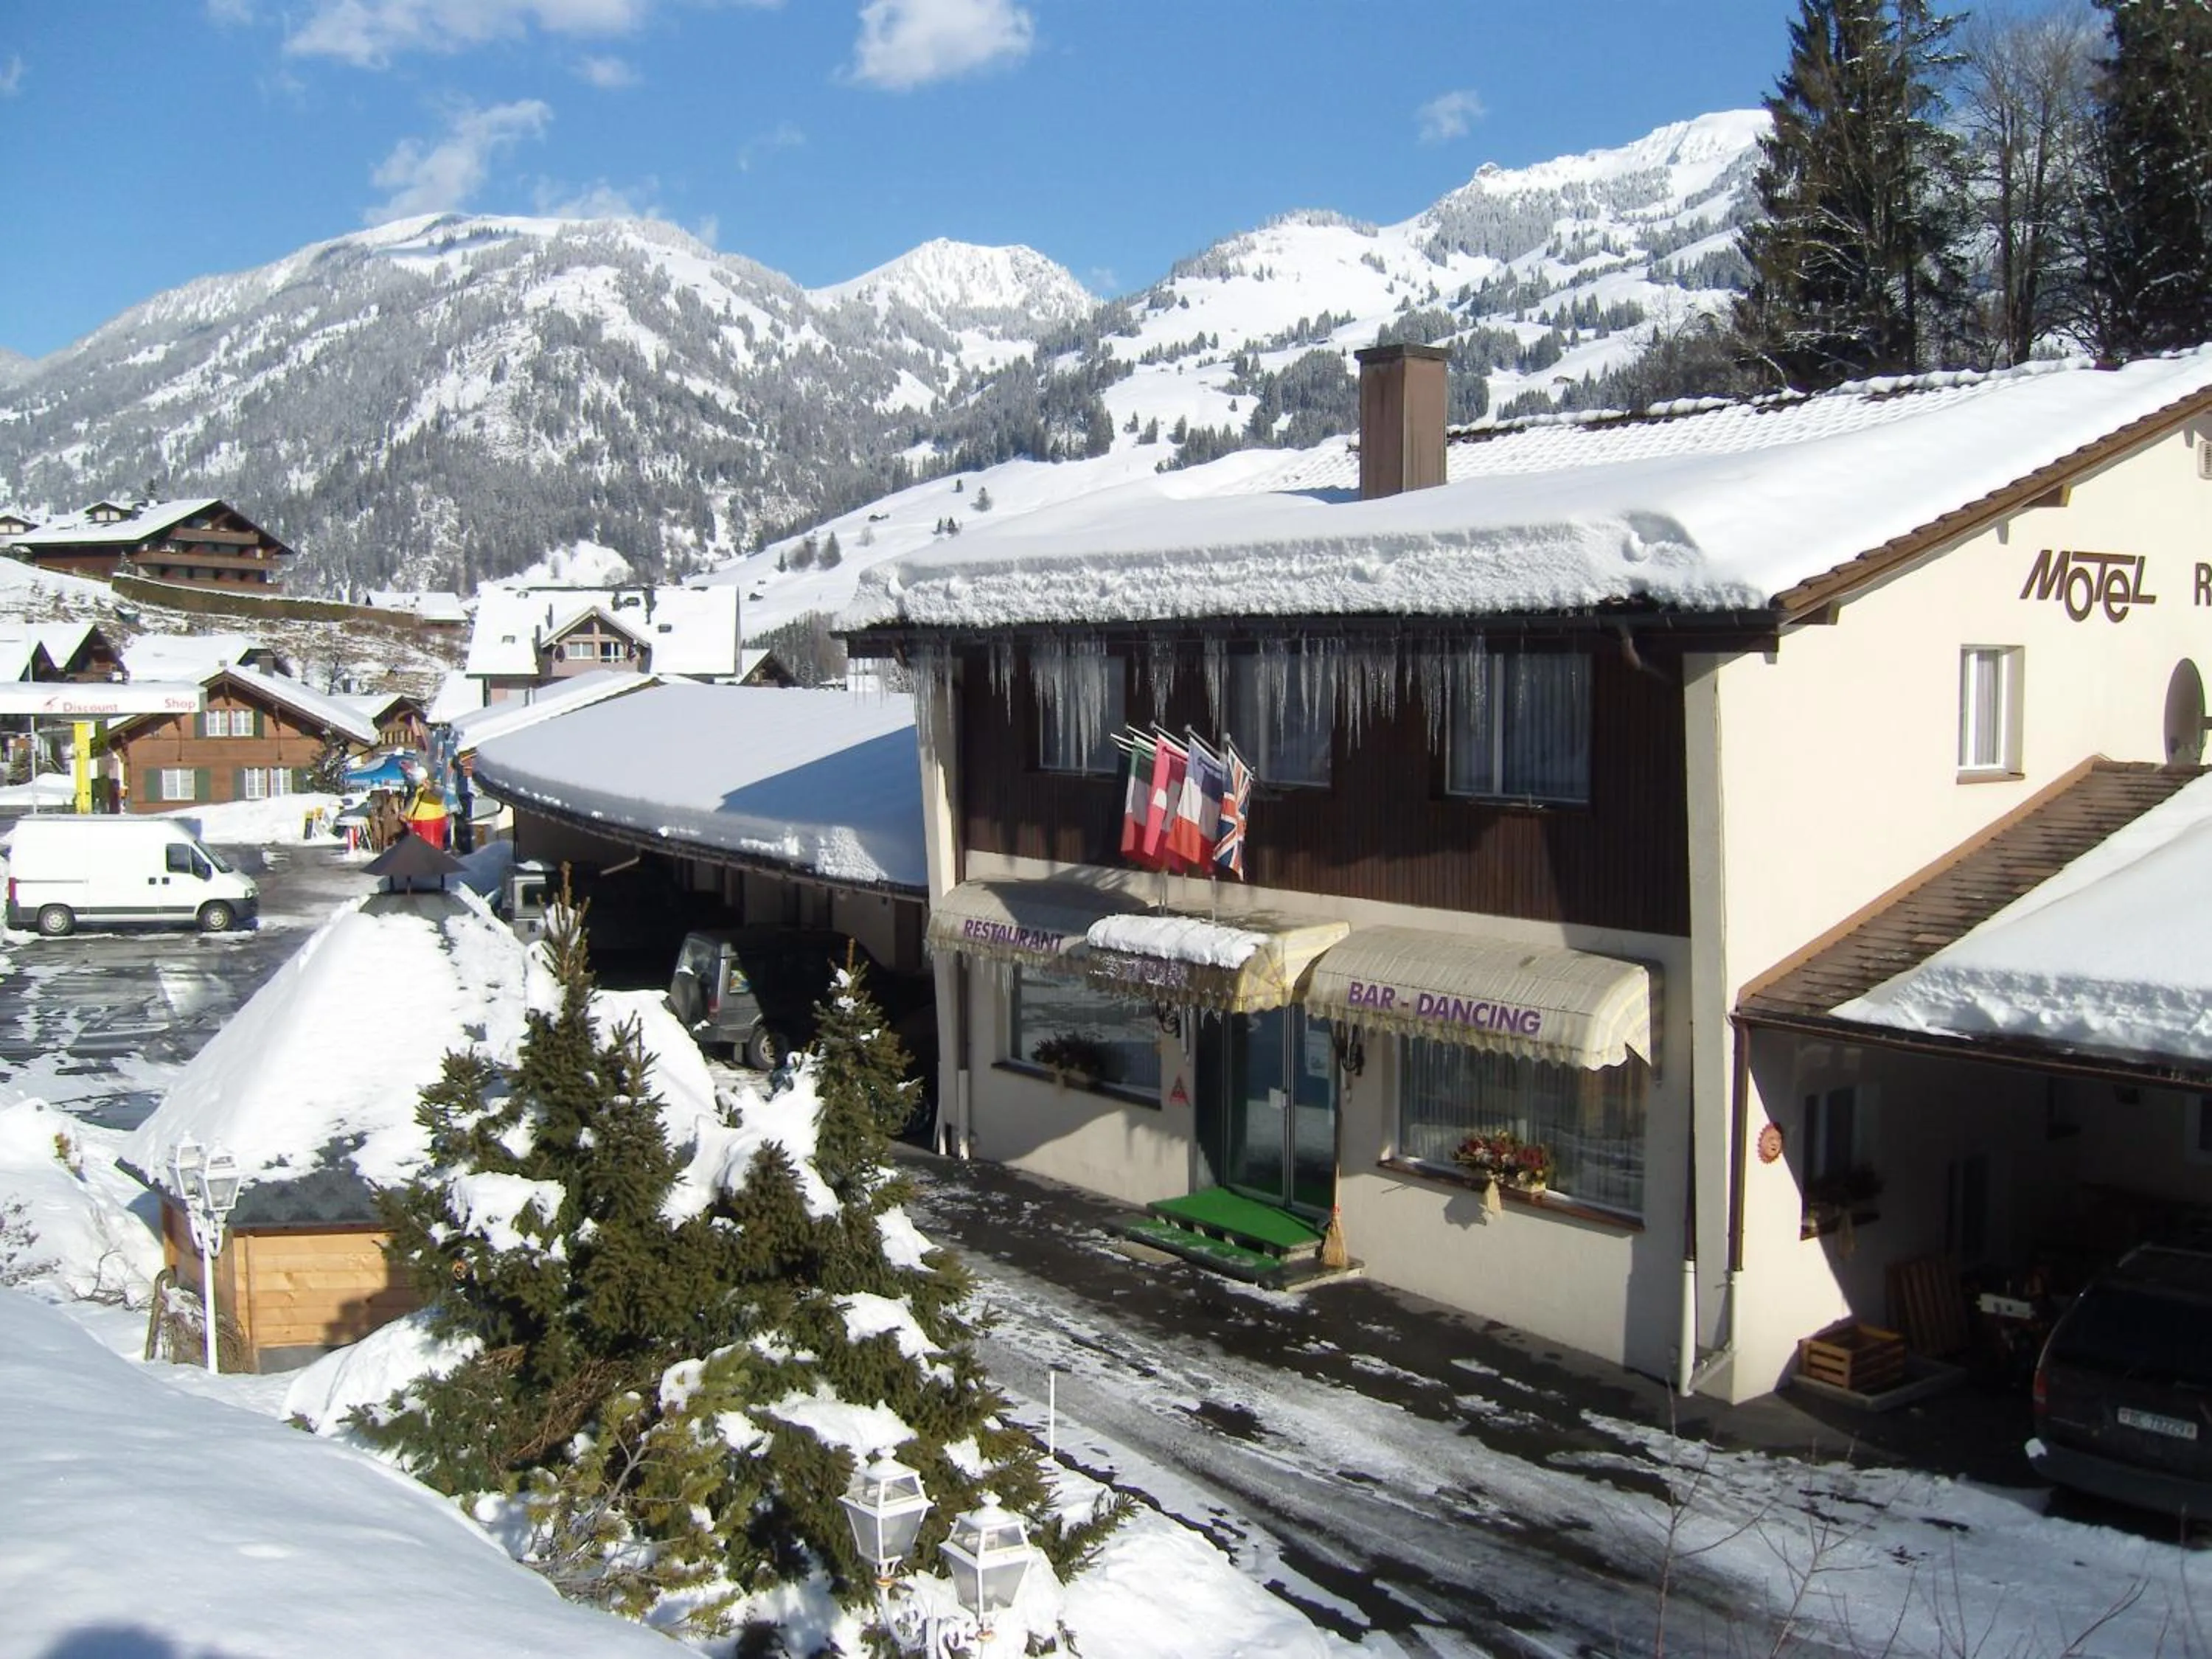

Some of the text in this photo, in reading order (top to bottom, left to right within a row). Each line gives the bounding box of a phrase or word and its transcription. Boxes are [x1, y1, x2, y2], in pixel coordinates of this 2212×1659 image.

[63, 698, 196, 713] Discount Shop
[963, 919, 1065, 955] RESTAURANT
[1348, 981, 1396, 1010] BAR
[1415, 992, 1541, 1035] DANCING
